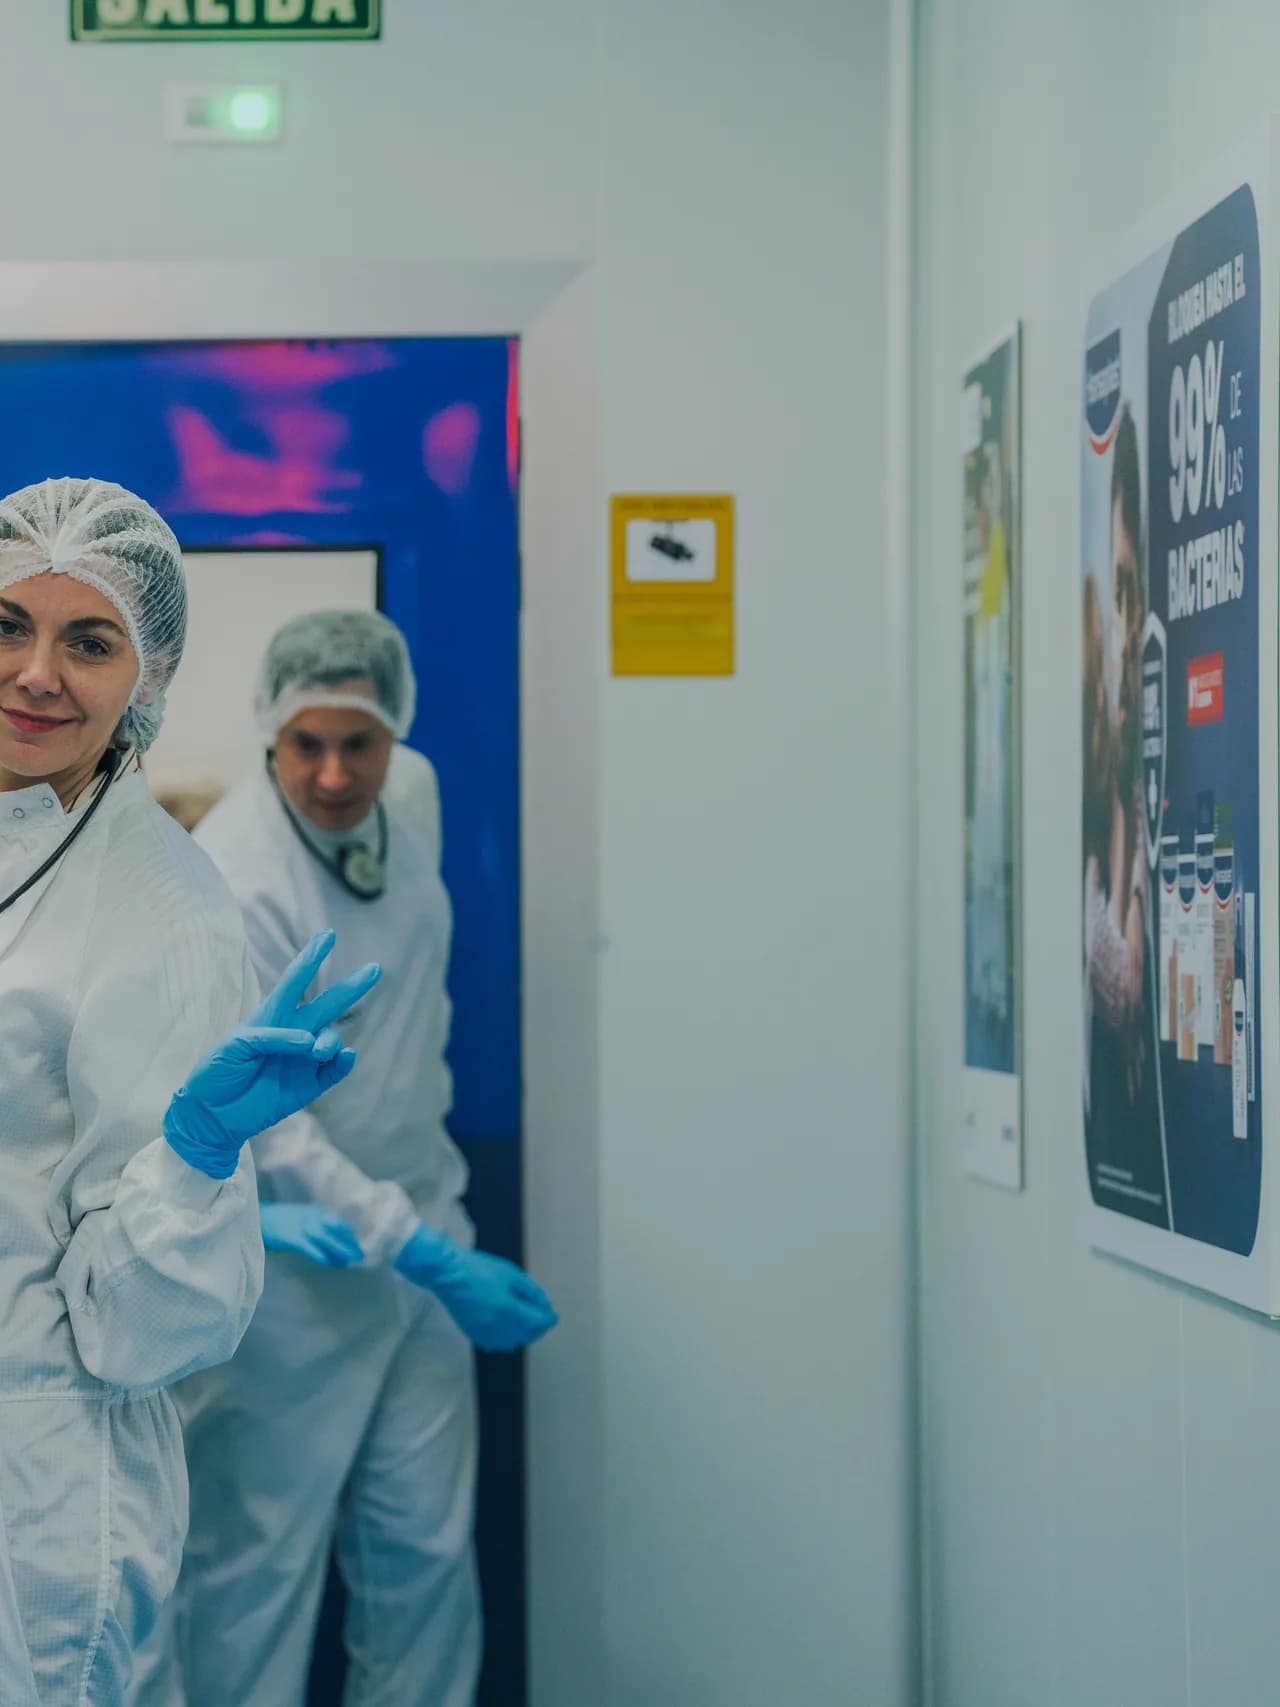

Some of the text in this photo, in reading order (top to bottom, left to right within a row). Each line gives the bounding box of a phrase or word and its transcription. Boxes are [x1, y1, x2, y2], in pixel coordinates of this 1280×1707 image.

[1206, 260, 1233, 319] HASTA
[1234, 253, 1246, 301] EL
[1230, 371, 1242, 419] DE
[1169, 340, 1226, 523] 99%
[1228, 446, 1243, 496] LAS
[1168, 519, 1245, 622] BACTERIAS
